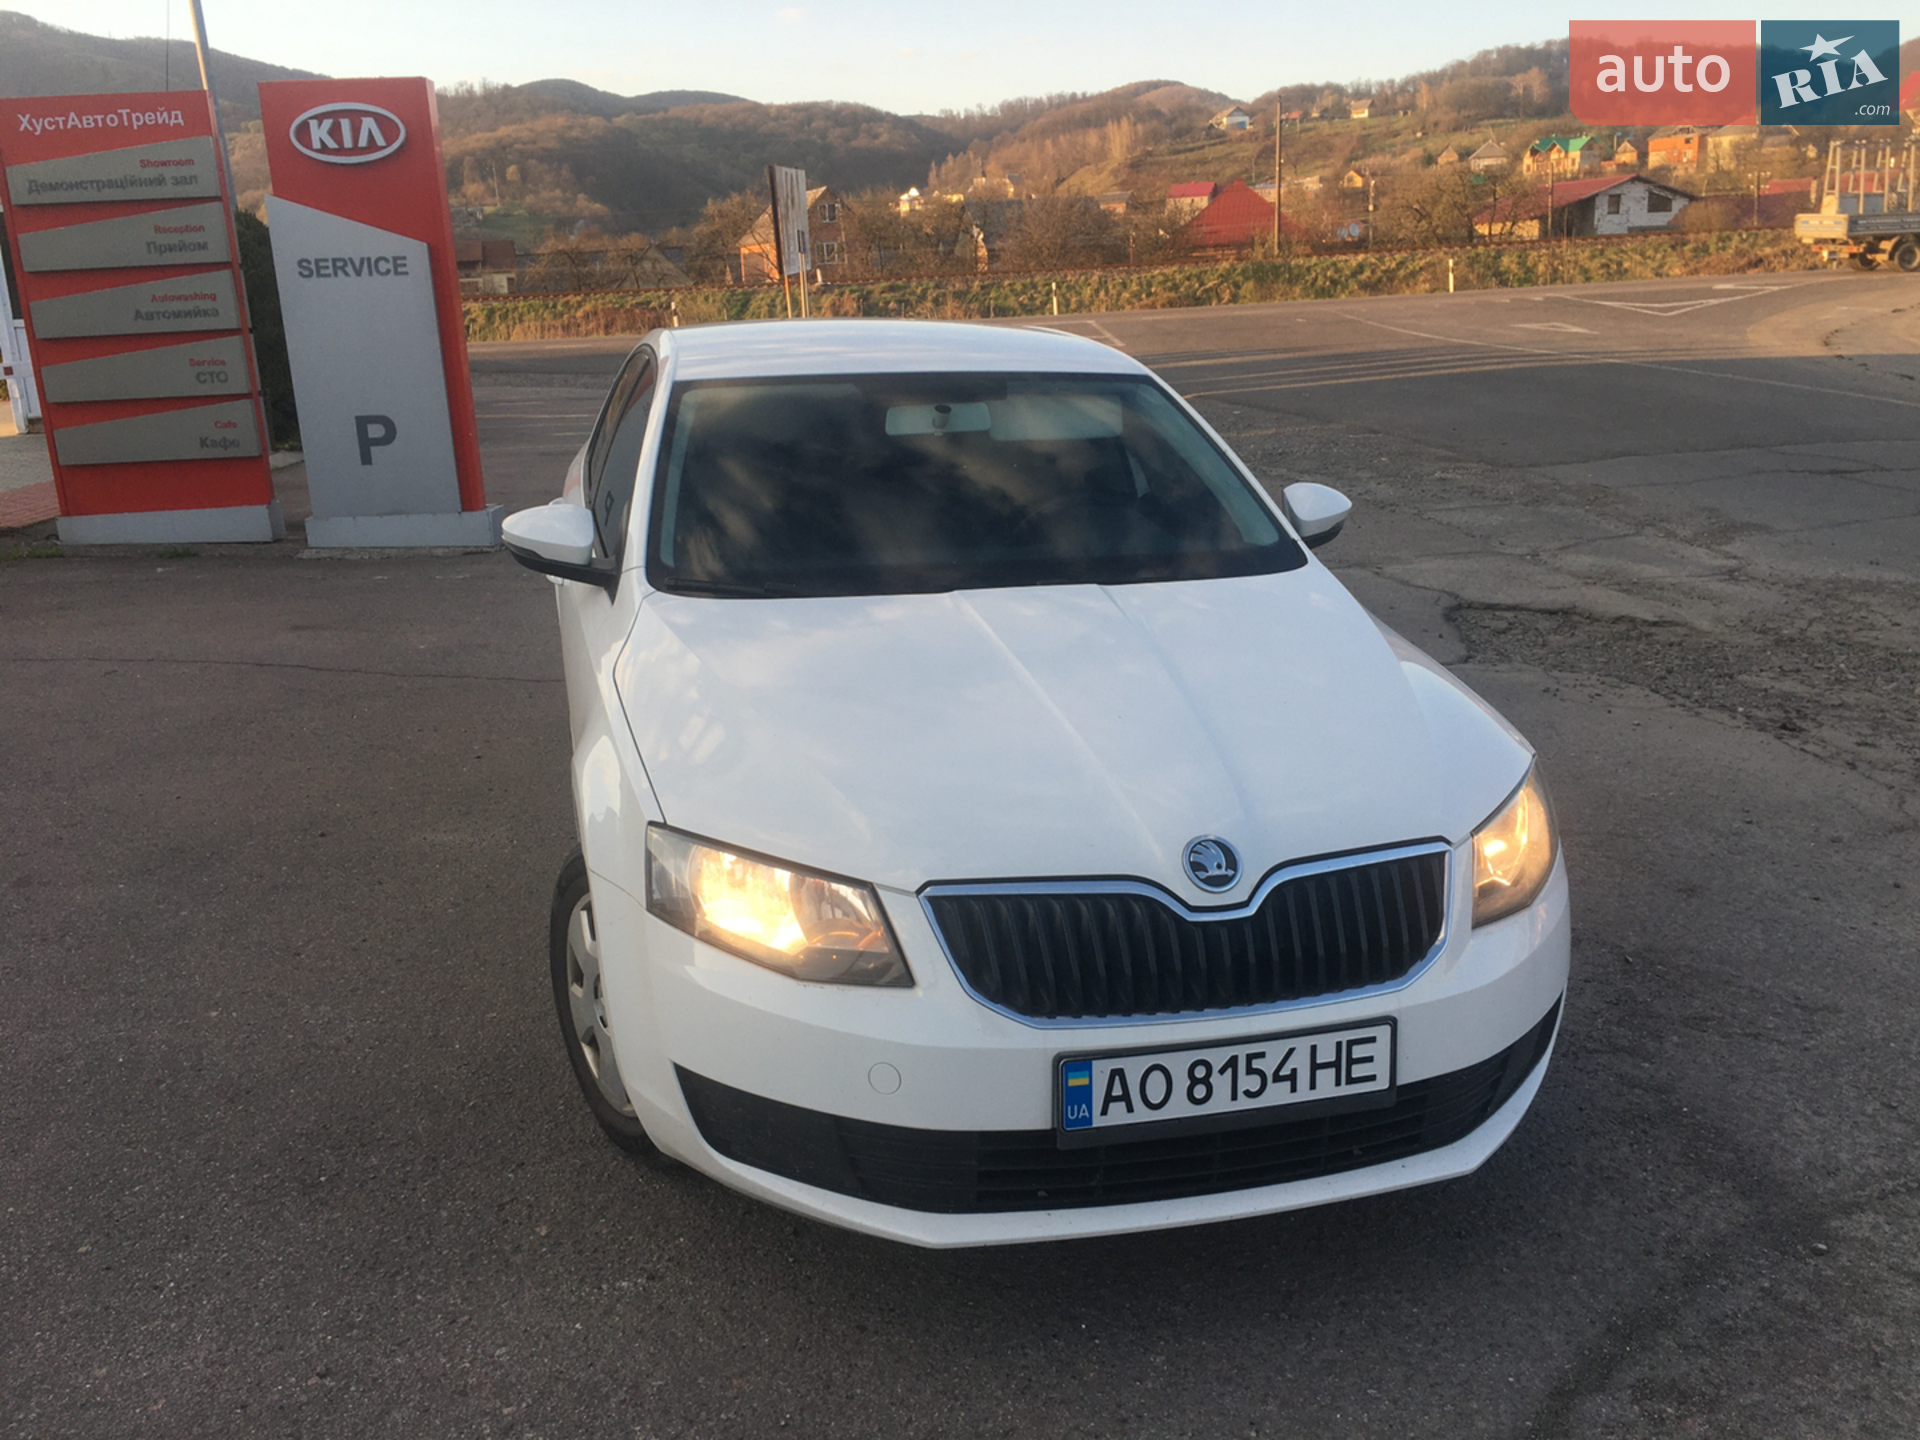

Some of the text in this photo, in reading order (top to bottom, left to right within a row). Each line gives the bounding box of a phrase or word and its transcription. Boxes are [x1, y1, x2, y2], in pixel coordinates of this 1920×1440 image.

[17, 107, 184, 136] ХустАвтоТрейд
[308, 116, 388, 150] KIA
[139, 158, 195, 169] Showroom
[27, 174, 198, 196] Демонстраційний зал
[154, 224, 205, 234] Reception
[146, 240, 209, 257] Прийом
[297, 255, 409, 279] SERVICE
[134, 305, 219, 321] Автомийка
[189, 357, 227, 367] Service
[199, 436, 240, 451] Кафе
[354, 413, 398, 466] P
[1186, 1046, 1298, 1106] 8154
[1067, 1104, 1090, 1120] UA
